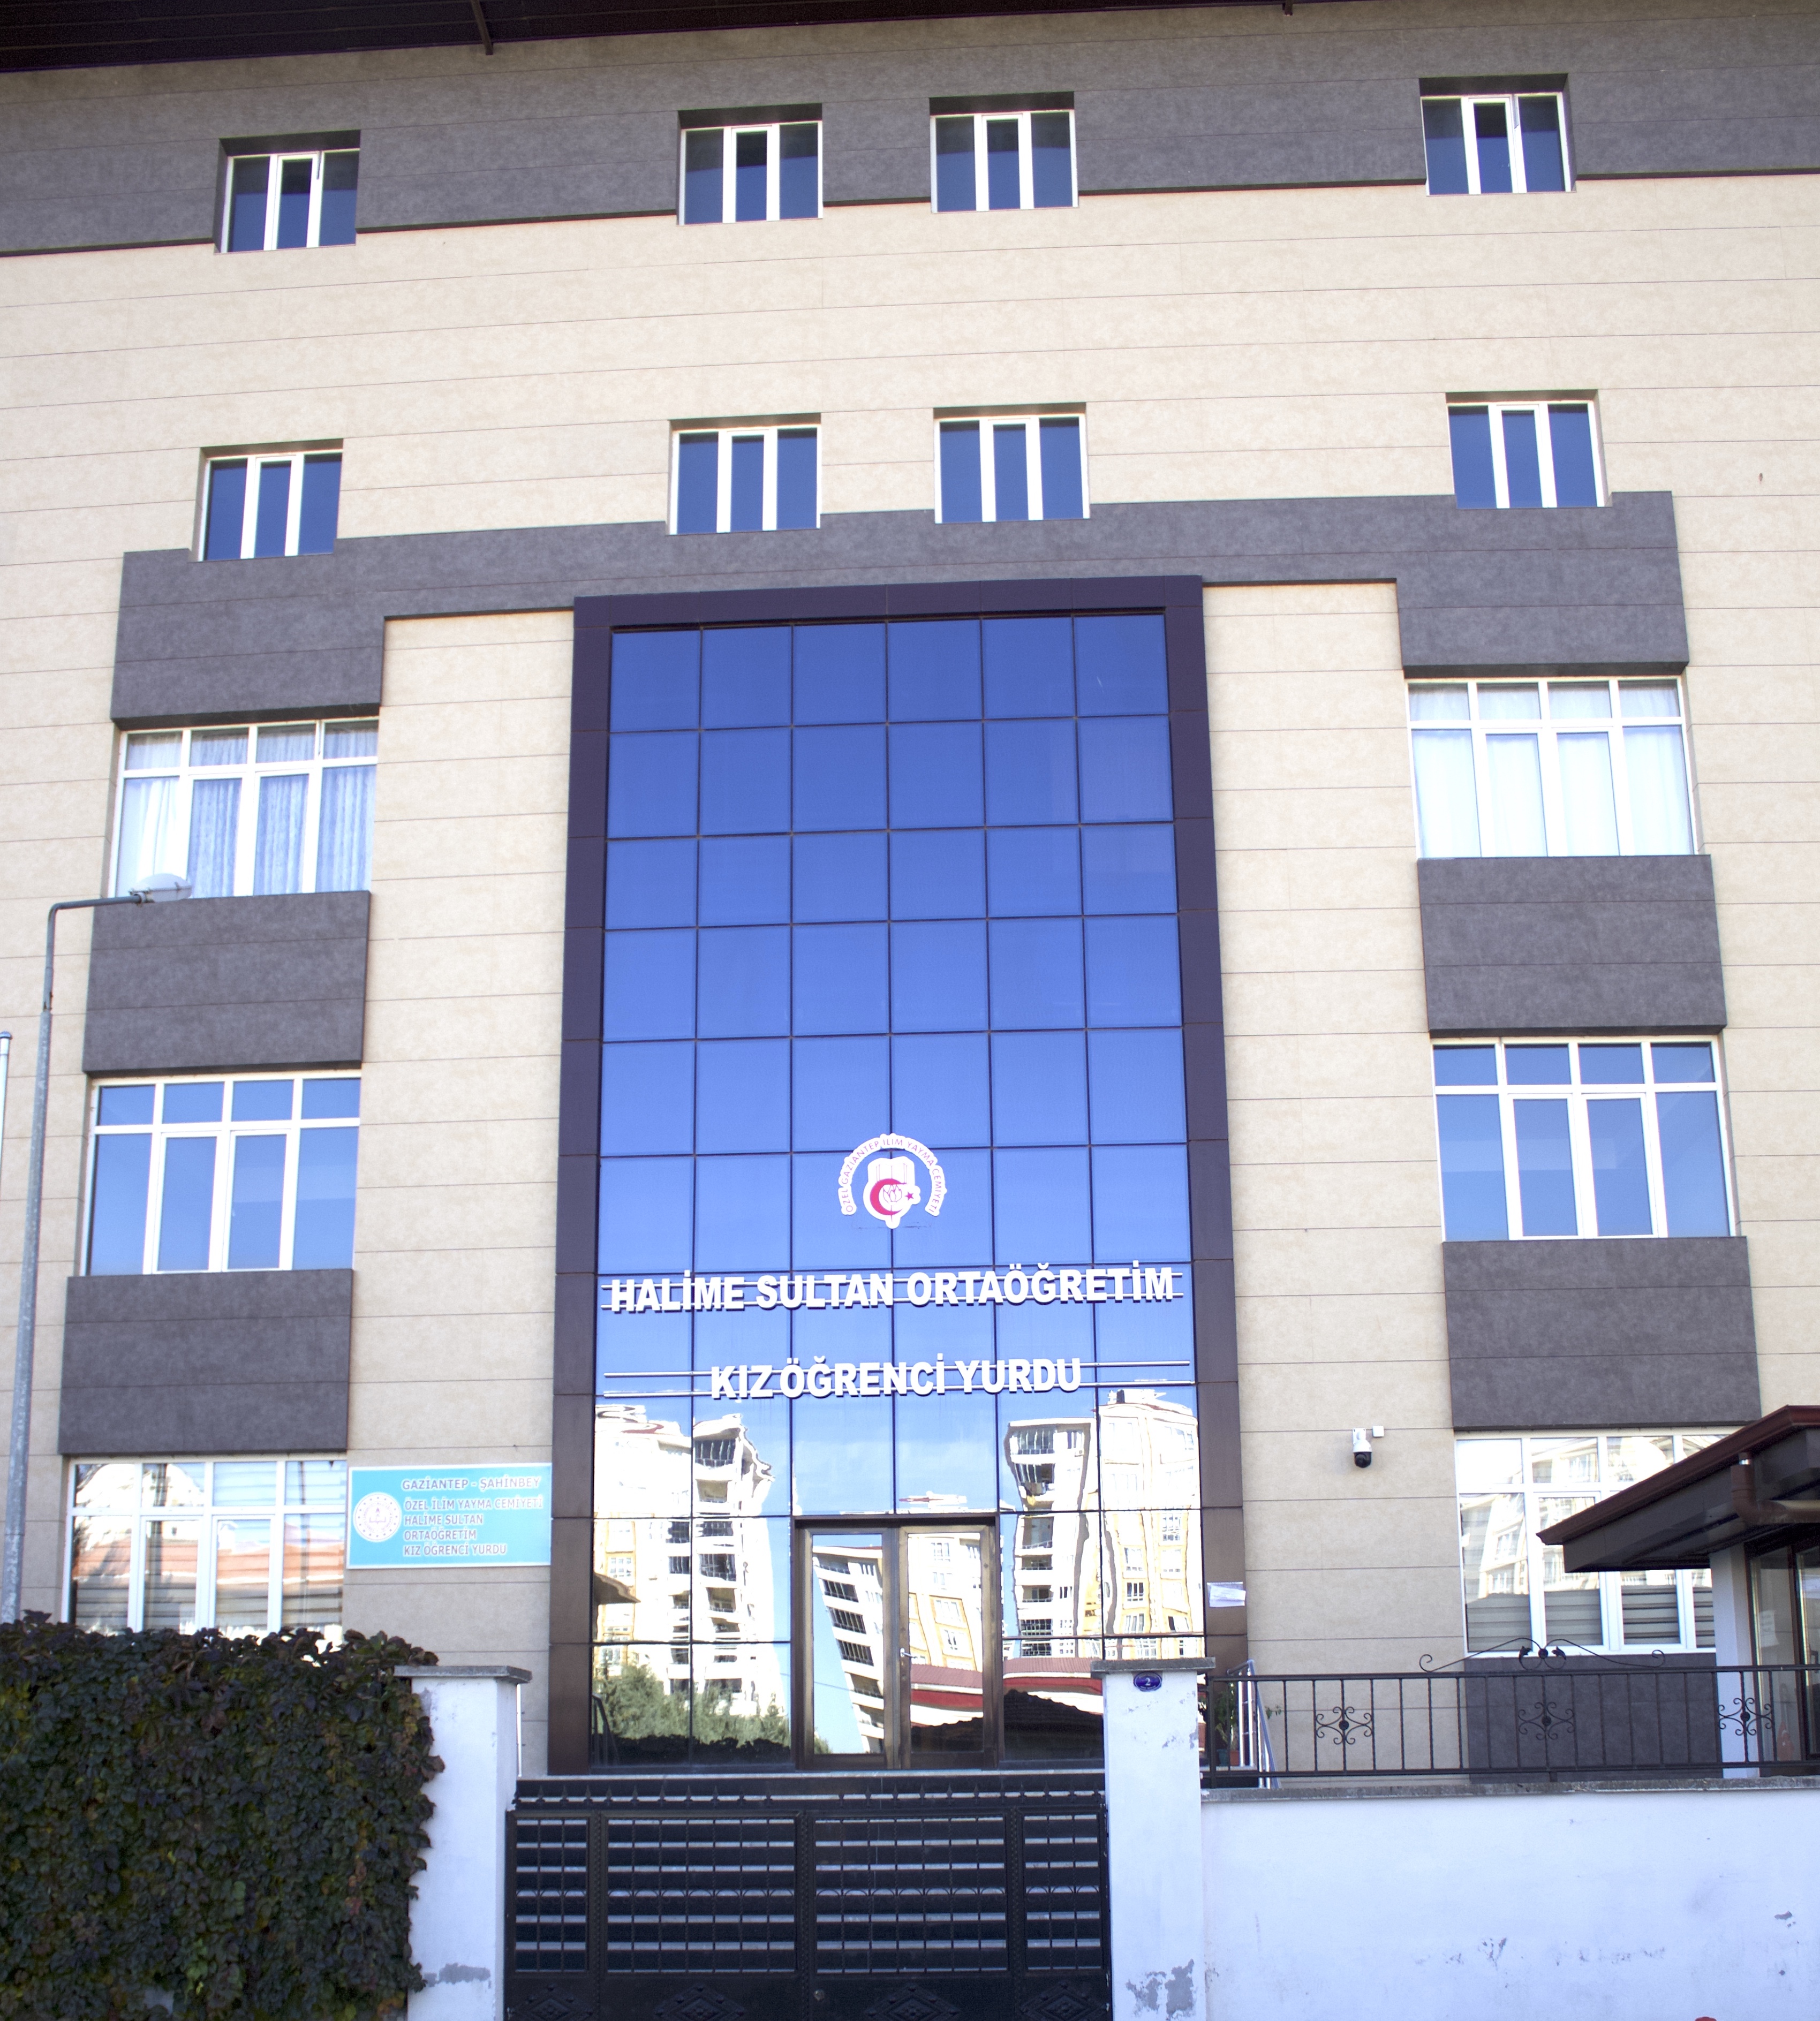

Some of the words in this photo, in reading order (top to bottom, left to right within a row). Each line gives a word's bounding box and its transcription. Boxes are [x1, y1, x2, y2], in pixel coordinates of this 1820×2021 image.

[908, 1142, 934, 1166] YAYMA
[611, 1270, 745, 1312] HALİME
[756, 1273, 893, 1308] SULTAN
[907, 1260, 1173, 1306] ORTAÖĞRETİM
[711, 1365, 774, 1399] KIZ
[780, 1353, 945, 1398] ÖĞRENCİ
[954, 1358, 1081, 1393] YURDU
[402, 1477, 468, 1489] GAZİANTEP
[480, 1475, 540, 1490] ŞAHİNBEY
[405, 1497, 429, 1510] ÖZEL
[432, 1497, 455, 1509] İLİM
[458, 1498, 492, 1509] YAYMA
[495, 1495, 542, 1508] CEMİYETİ
[404, 1513, 442, 1525] HALİME
[445, 1515, 483, 1525] SULTAN
[404, 1527, 477, 1540] ORTAÖĞRETİM
[404, 1546, 420, 1555] KIZ
[424, 1542, 469, 1555] ÖĞRENCİ
[472, 1545, 507, 1554] YURDU
[1145, 1677, 1151, 1686] 2
